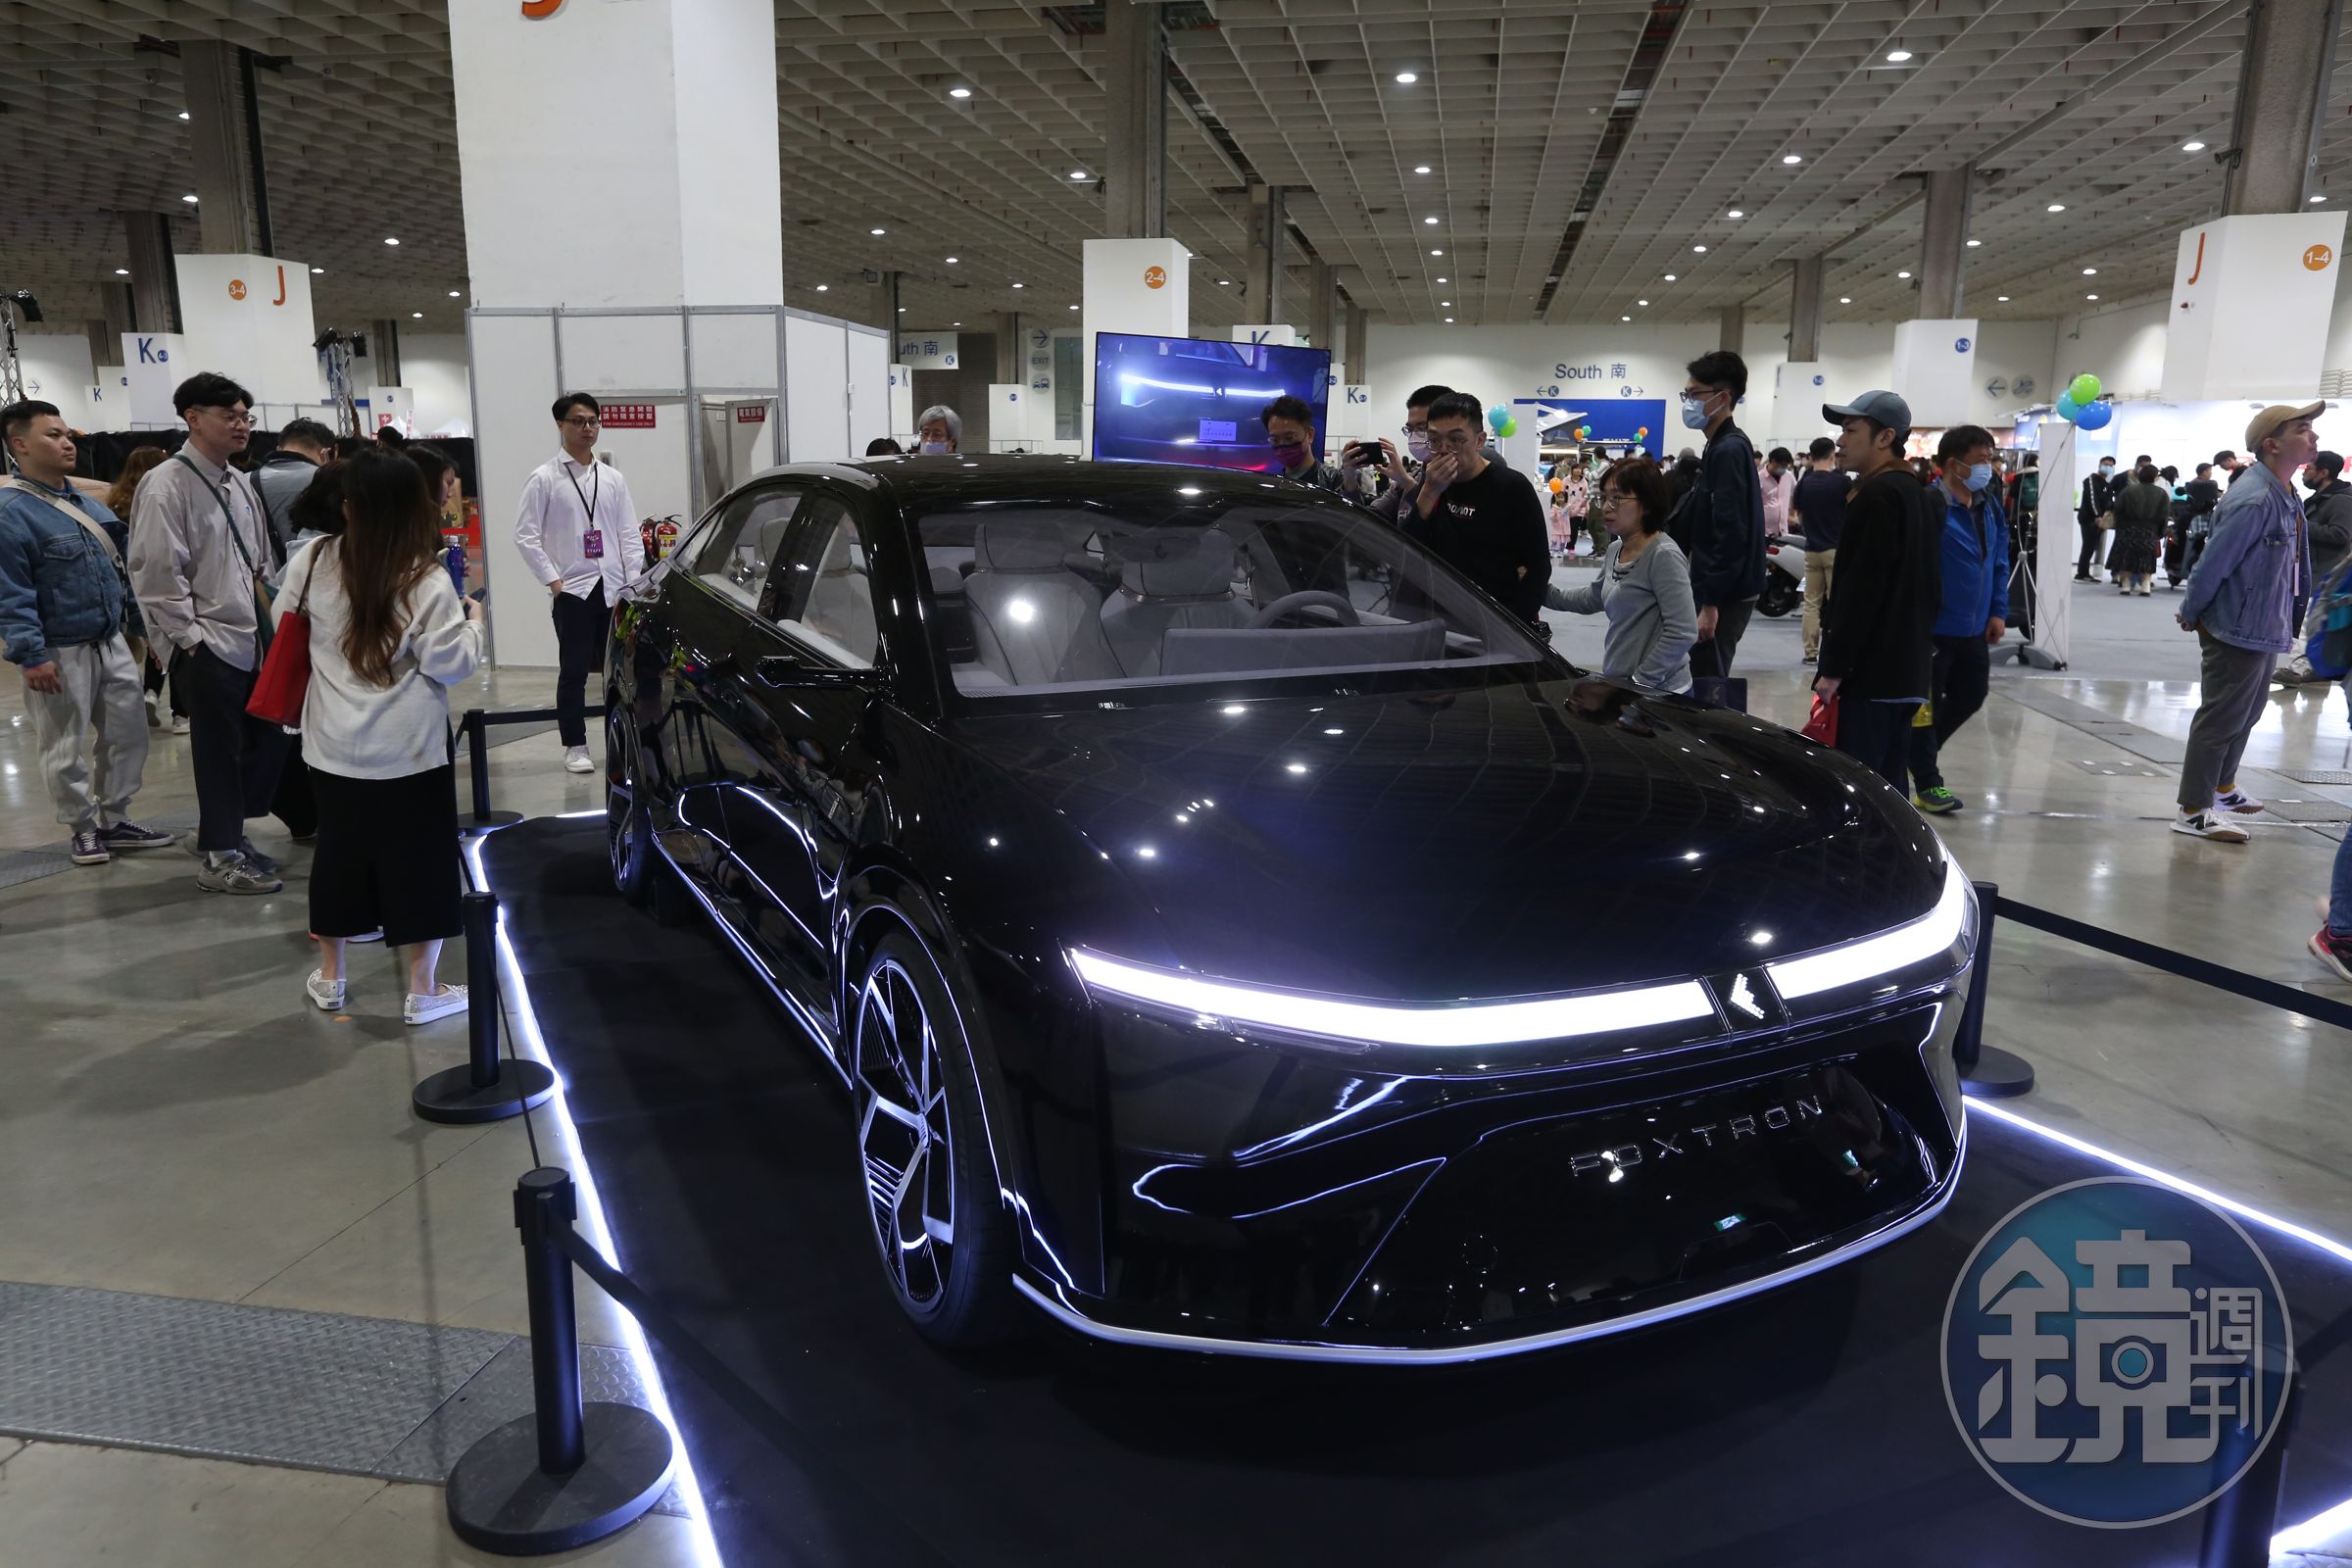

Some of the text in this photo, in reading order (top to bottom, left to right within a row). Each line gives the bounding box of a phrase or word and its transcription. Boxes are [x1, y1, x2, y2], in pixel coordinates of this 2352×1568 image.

[2187, 231, 2206, 285] J
[2306, 250, 2330, 265] 1-4
[1146, 271, 1166, 283] 2-4
[273, 266, 286, 306] J
[138, 337, 157, 364] K
[900, 341, 939, 356] uth 南
[1554, 363, 1627, 379] South 南
[1348, 387, 1359, 404] K
[1570, 1095, 1823, 1178] FOXTRON
